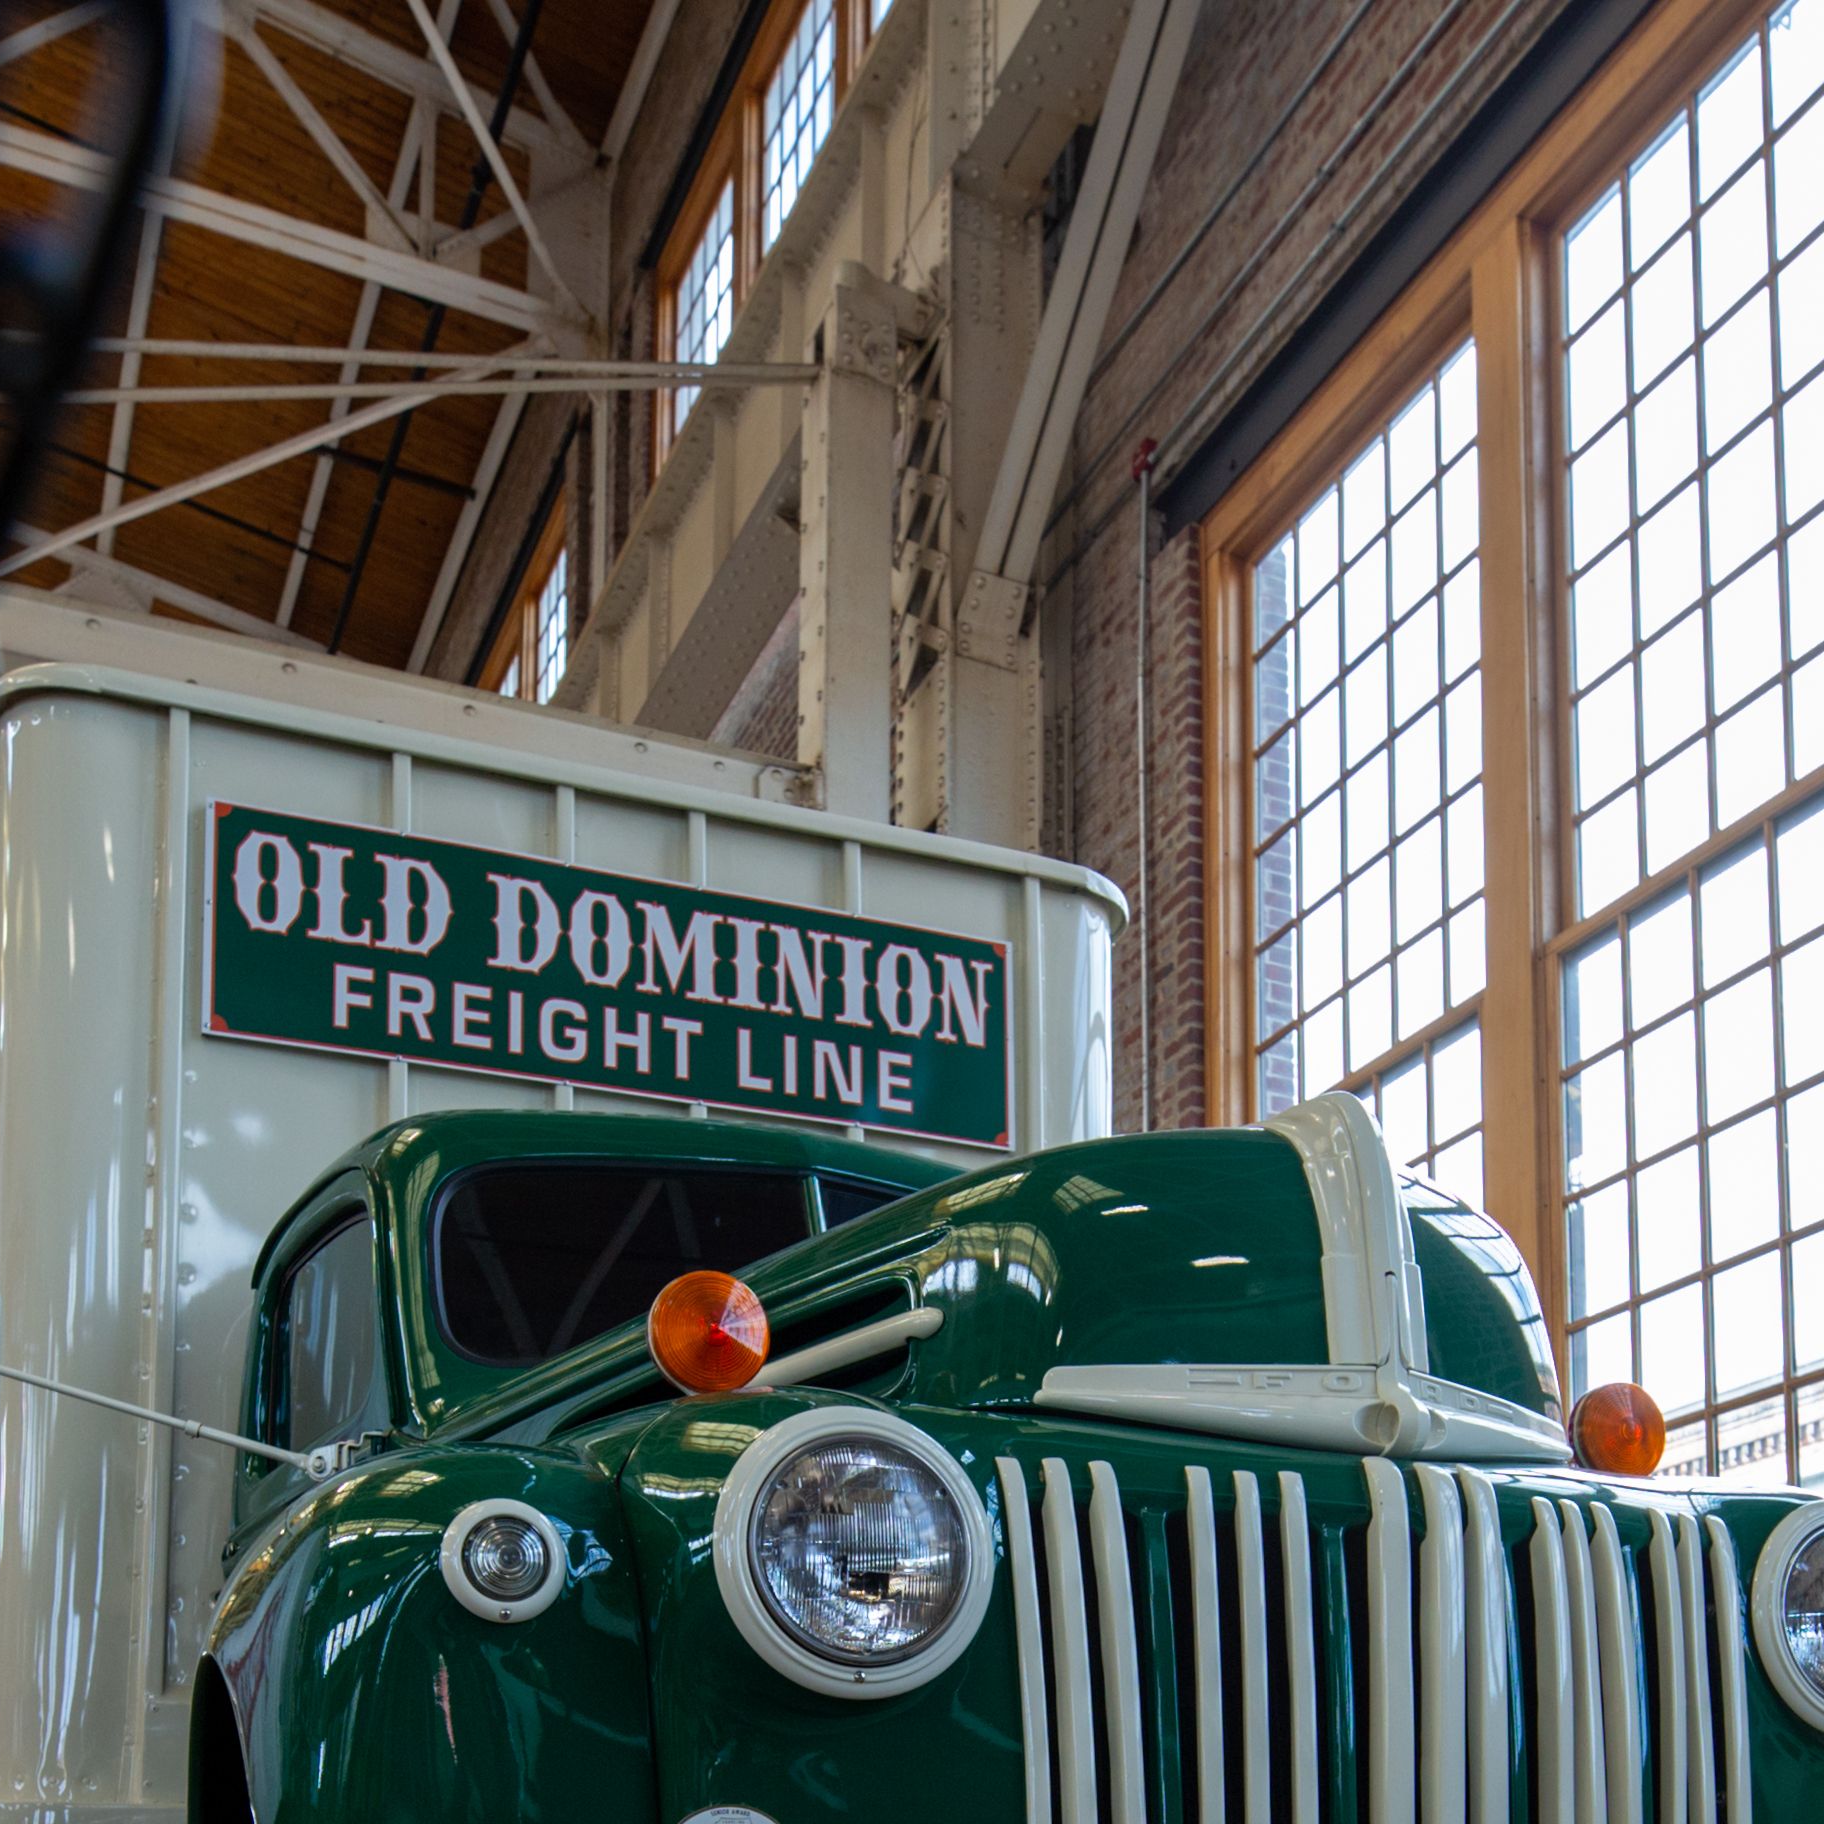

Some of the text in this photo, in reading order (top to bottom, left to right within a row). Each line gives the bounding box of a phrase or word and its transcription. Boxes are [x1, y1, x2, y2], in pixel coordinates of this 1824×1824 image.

[231, 829, 994, 1049] OLD DOMINION
[332, 962, 915, 1114] FREIGHT LINE
